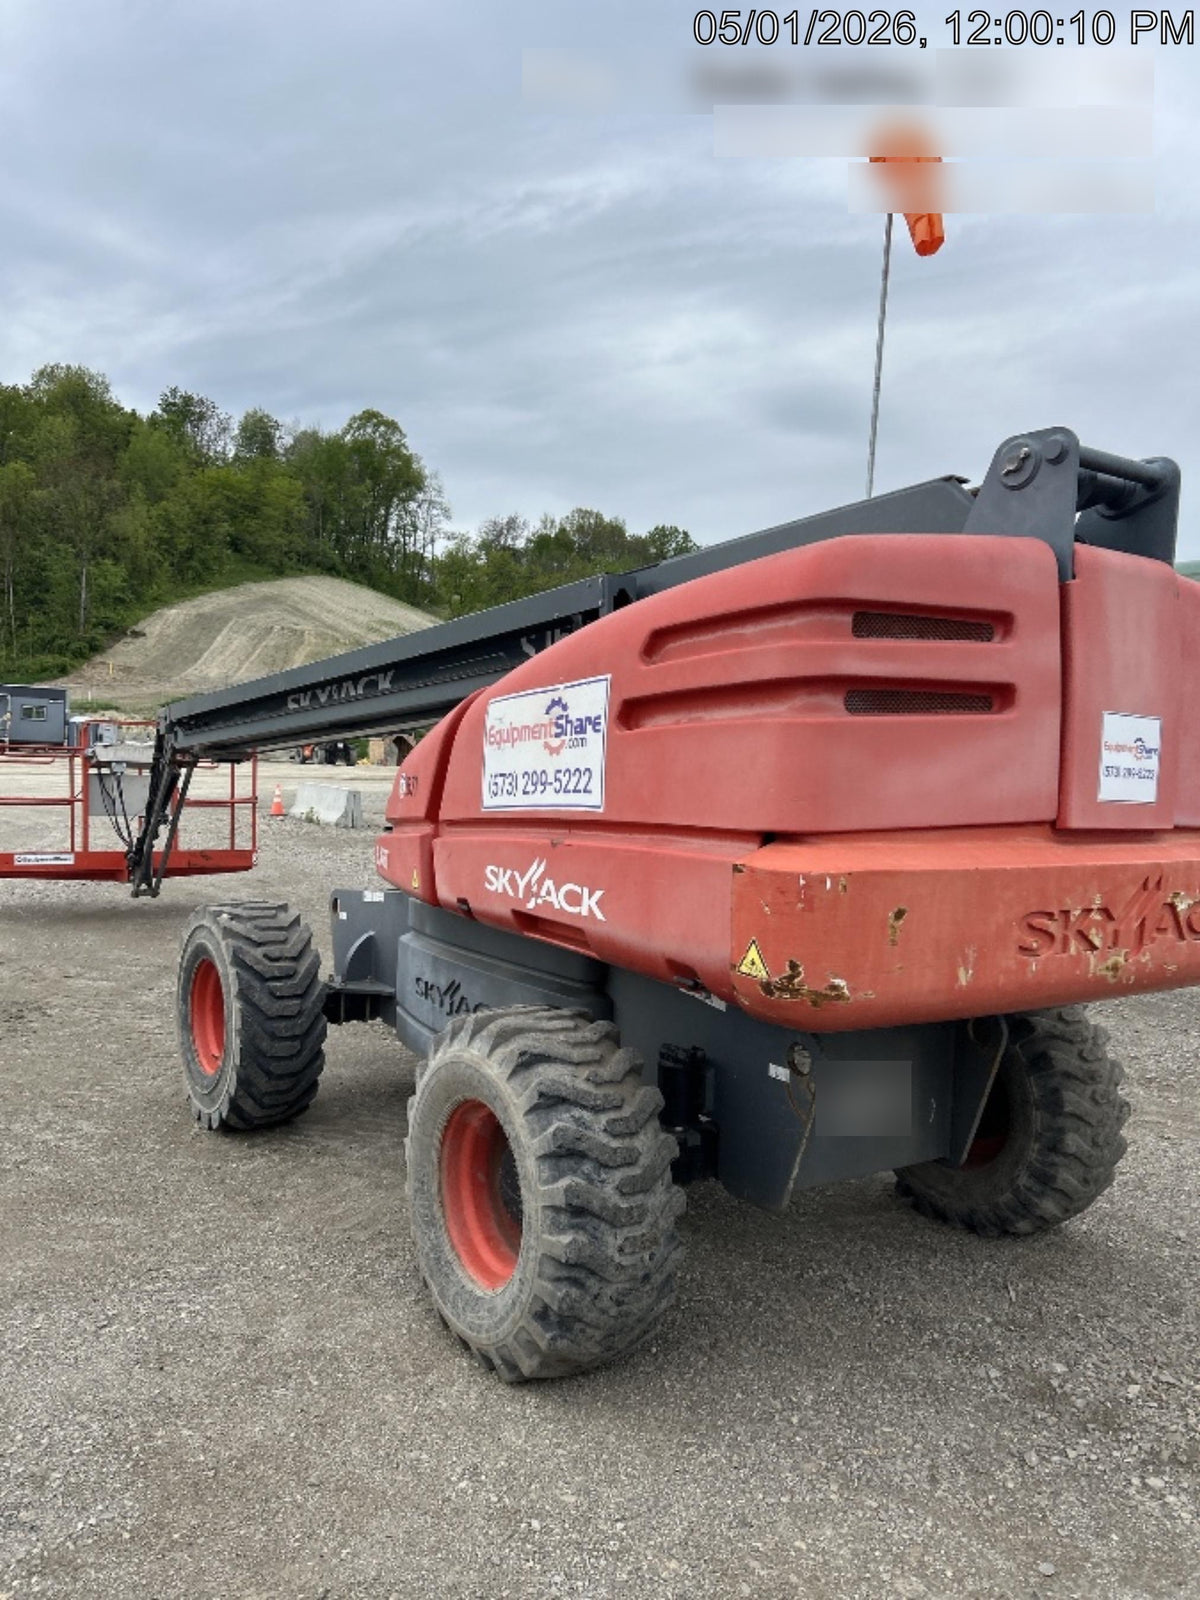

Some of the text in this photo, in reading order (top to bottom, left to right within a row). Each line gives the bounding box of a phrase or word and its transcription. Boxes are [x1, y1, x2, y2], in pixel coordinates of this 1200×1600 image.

[488, 714, 602, 748] EquipmentShare
[489, 767, 593, 798] (573) 299-5222
[484, 856, 606, 922] SKYJACK
